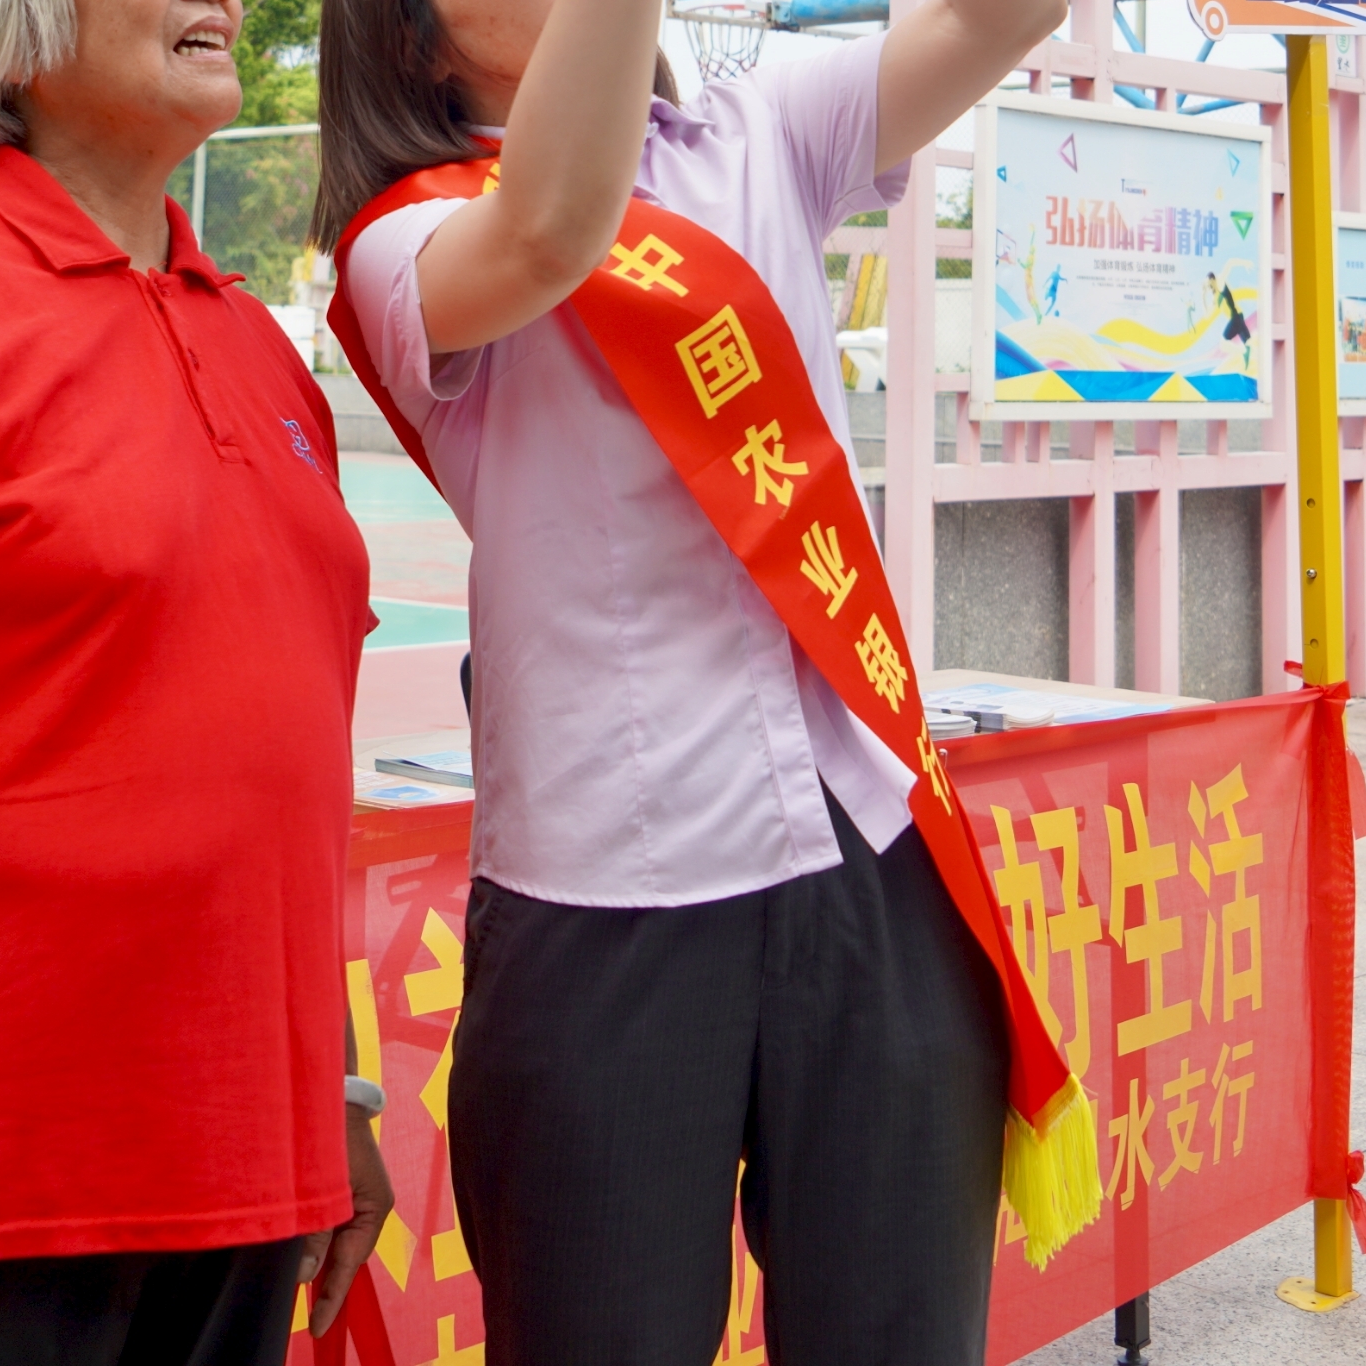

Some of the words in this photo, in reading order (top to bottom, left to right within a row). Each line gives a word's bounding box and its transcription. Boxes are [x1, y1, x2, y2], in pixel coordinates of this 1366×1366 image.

[1045, 195, 1220, 257] 弘扬体育精神
[1085, 1039, 1256, 1212] 水支行
